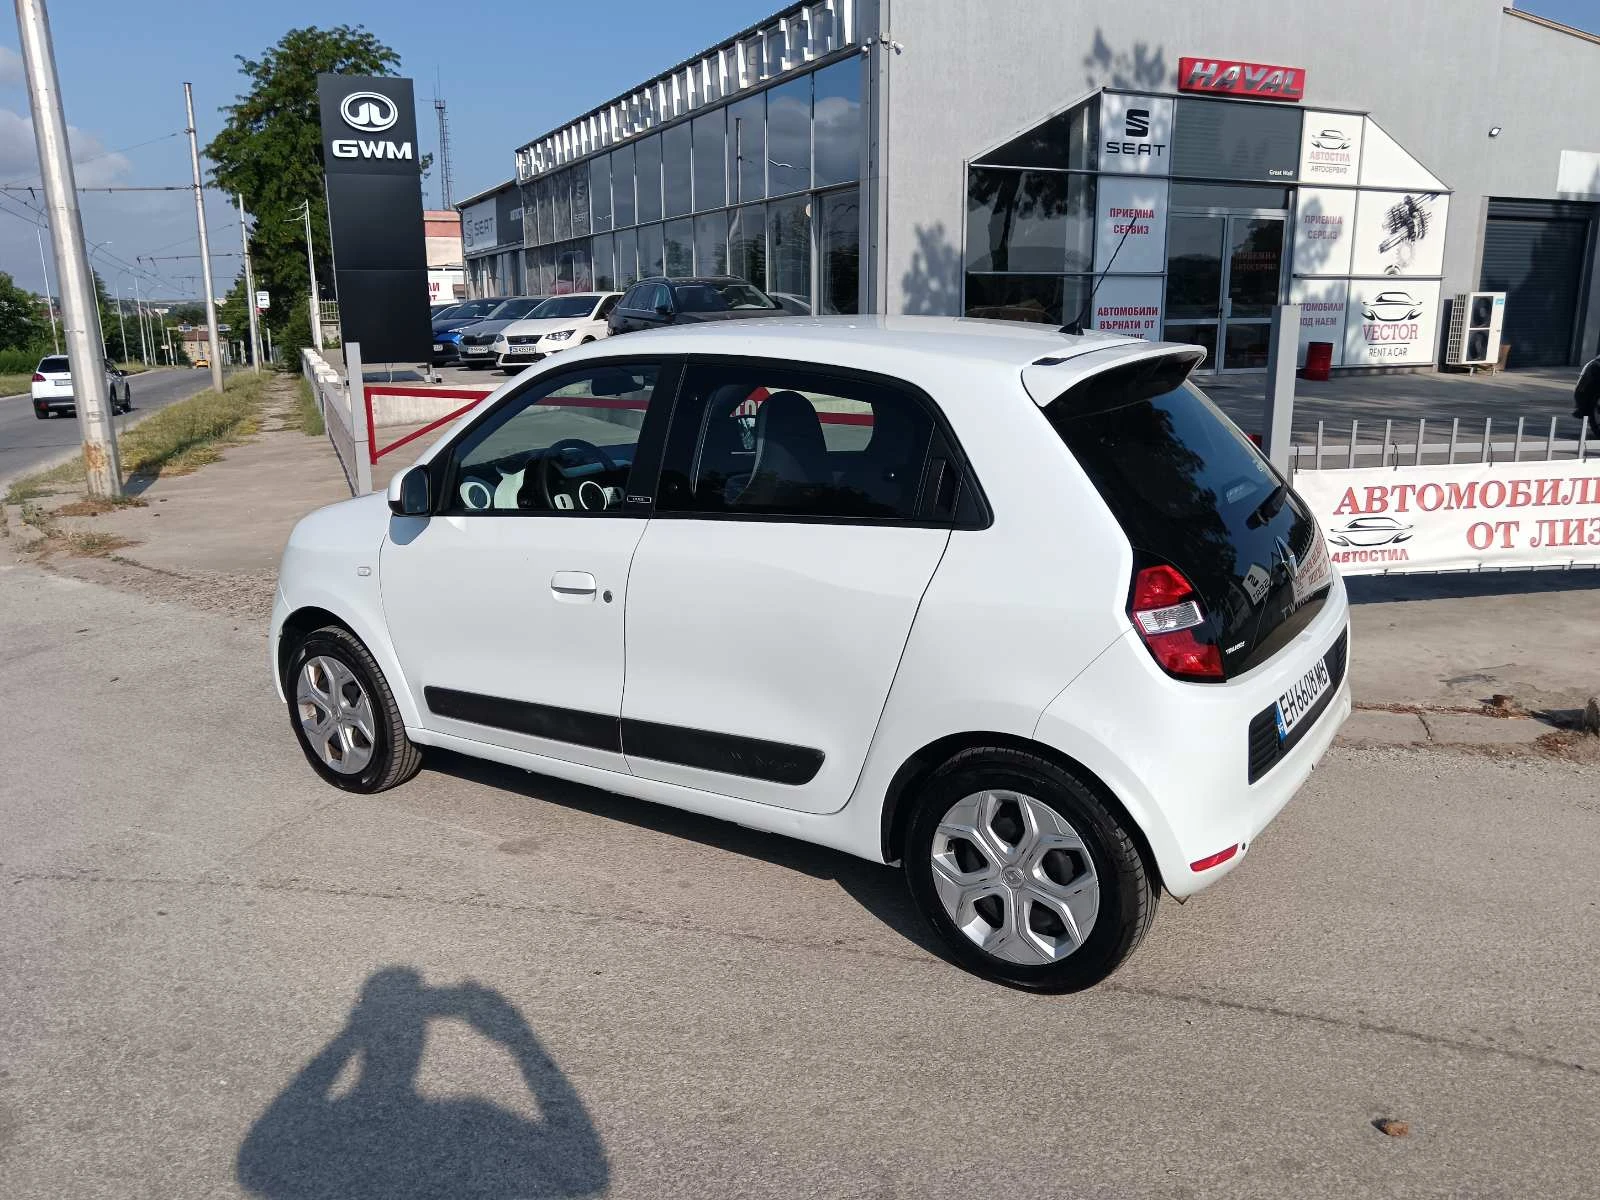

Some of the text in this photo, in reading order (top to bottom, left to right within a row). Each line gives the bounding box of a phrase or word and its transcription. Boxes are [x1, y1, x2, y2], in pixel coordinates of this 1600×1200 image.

[1187, 61, 1302, 95] HAVAL
[332, 139, 413, 160] GWM
[1106, 142, 1166, 156] SEAT
[1109, 207, 1155, 218] ПРИЕМНА
[474, 217, 494, 236] SEAT
[1113, 224, 1149, 235] СЕРВИЗ
[1097, 306, 1158, 317] АВТОМОБИЛИ
[1100, 320, 1155, 330] ВЪРНАТИ ОТ
[1362, 323, 1419, 341] VECTOR
[1369, 347, 1386, 357] RENT
[1394, 347, 1408, 357] CAR
[1466, 521, 1520, 550] ОТ
[1331, 549, 1409, 564] АВТОСТИЛ
